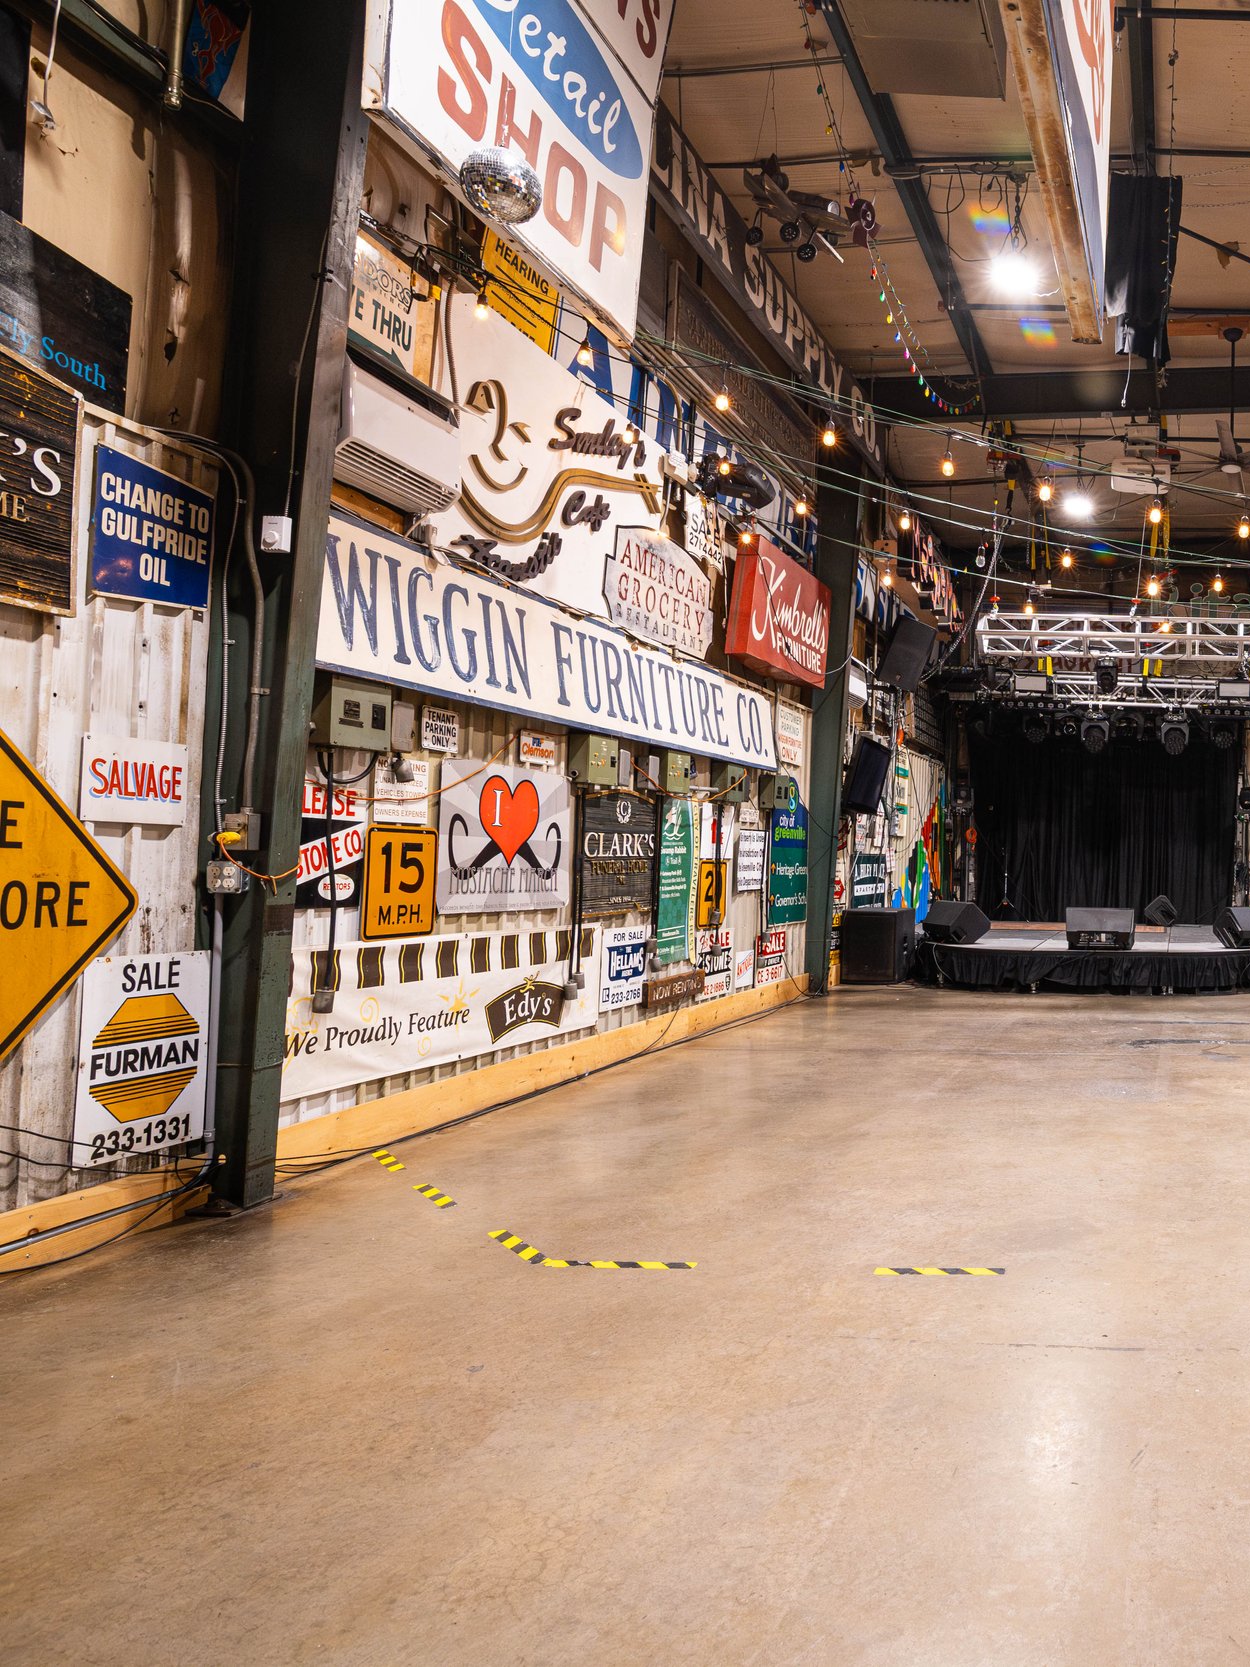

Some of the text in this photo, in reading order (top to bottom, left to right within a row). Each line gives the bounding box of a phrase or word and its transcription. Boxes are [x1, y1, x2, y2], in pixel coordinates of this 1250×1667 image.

[437, 0, 626, 272] SHOP
[495, 238, 549, 296] HEARING
[372, 296, 412, 351] THRU
[40, 336, 107, 391] South
[745, 244, 843, 404] SUPPLY
[851, 385, 881, 463] CO.
[101, 472, 209, 533] CHANGE TO
[102, 507, 207, 565] GULFPRIDE
[140, 553, 170, 586] OIL
[620, 540, 707, 607] AMERICAN
[618, 573, 705, 636] GROCERY
[752, 556, 827, 654] Kimbrell's
[615, 602, 704, 653] RESTAURANT
[325, 532, 532, 699] WIGGIN
[550, 621, 729, 747] FURNITURE
[737, 692, 770, 758] CO.
[777, 632, 822, 674] FURNITURE
[425, 722, 456, 738] PARKING
[427, 710, 455, 725] TENANT
[779, 709, 802, 726] CUSTOMER
[781, 722, 800, 737] PARKING
[432, 735, 451, 748] ONLY
[522, 744, 554, 759] Clemson
[781, 746, 797, 761] ONLY
[89, 758, 183, 803] SALVAGE
[376, 788, 404, 798] VEHICLES
[375, 808, 426, 818] OWNERS EXPENSE
[492, 789, 504, 827] I
[779, 813, 795, 828] city of
[584, 832, 655, 858] CLARK'S
[775, 825, 806, 842] greenville
[381, 841, 424, 893] 15
[448, 866, 559, 894] MUSTACHE MARCH
[776, 862, 808, 879] Heritage Green
[378, 904, 423, 926] M.P.H.
[775, 892, 797, 907] Governor's
[613, 930, 644, 943] FOR SALE
[766, 932, 785, 953] SALE
[121, 960, 181, 993] SALE
[610, 949, 645, 978] HELLAMS
[503, 990, 554, 1029] Edy's
[611, 987, 642, 1006] 233-2766
[652, 986, 671, 1001] NOW
[284, 1005, 470, 1059] We Proudly Feature
[89, 1038, 200, 1081] FURMAN
[91, 1113, 191, 1162] 233-1331
